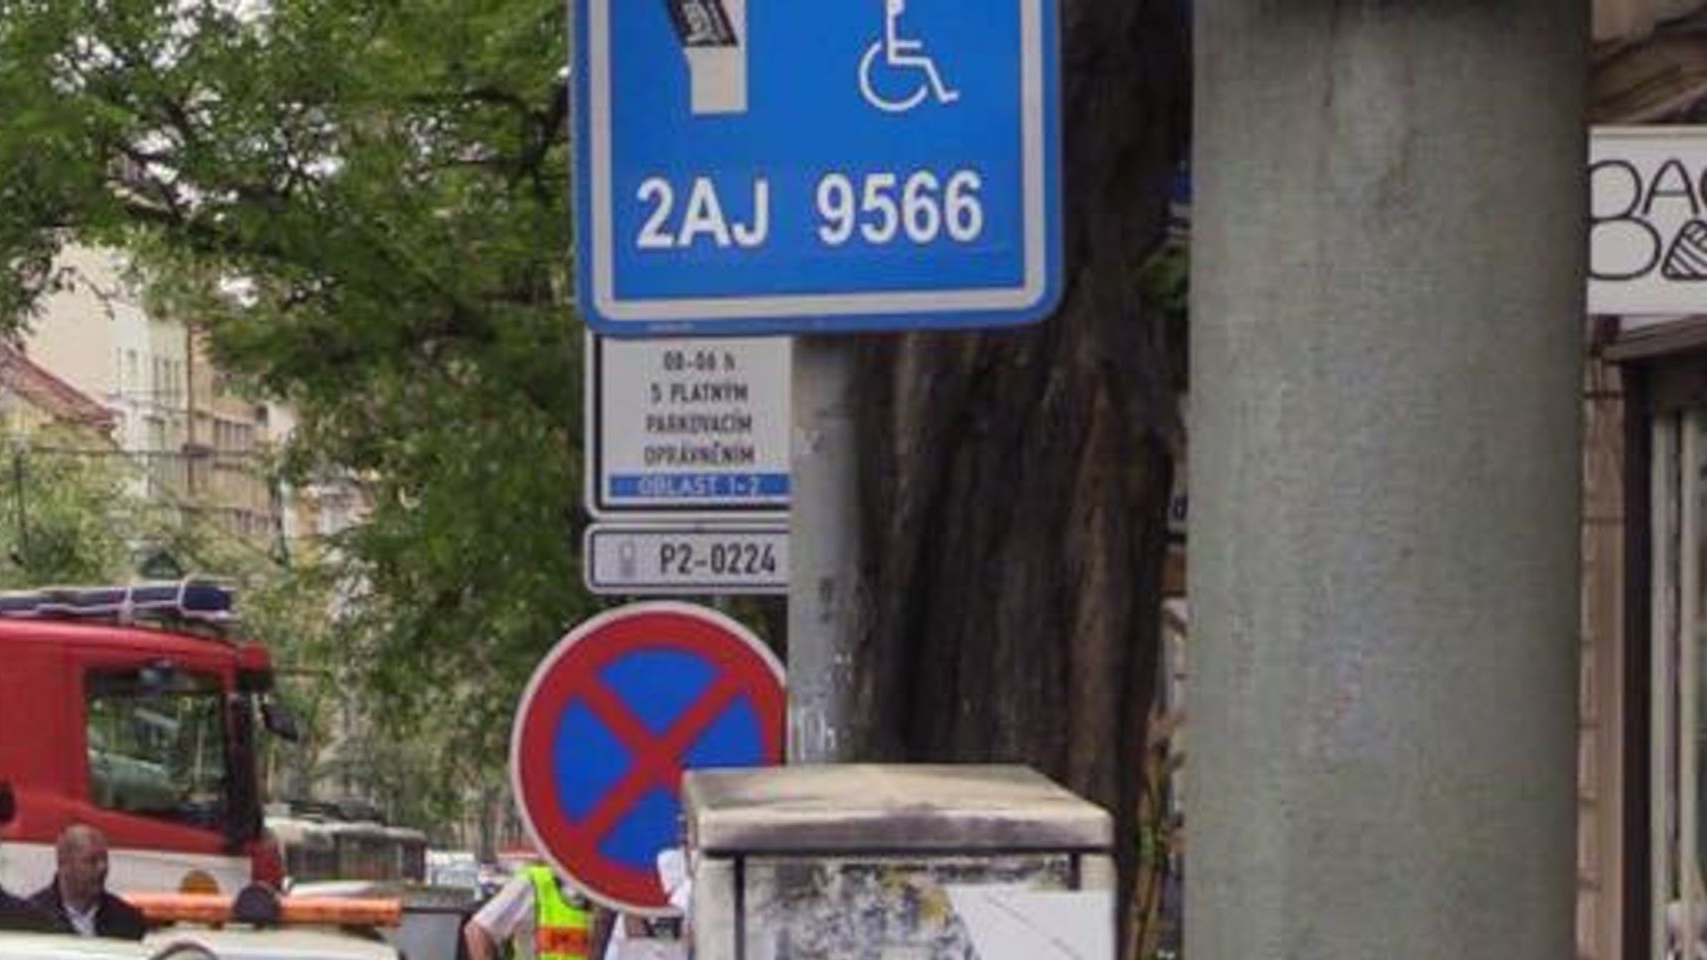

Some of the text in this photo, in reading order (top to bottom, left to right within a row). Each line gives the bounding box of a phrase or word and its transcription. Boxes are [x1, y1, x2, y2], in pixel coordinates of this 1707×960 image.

[636, 170, 984, 249] 2AJ 9566
[659, 542, 776, 575] P2-0224
